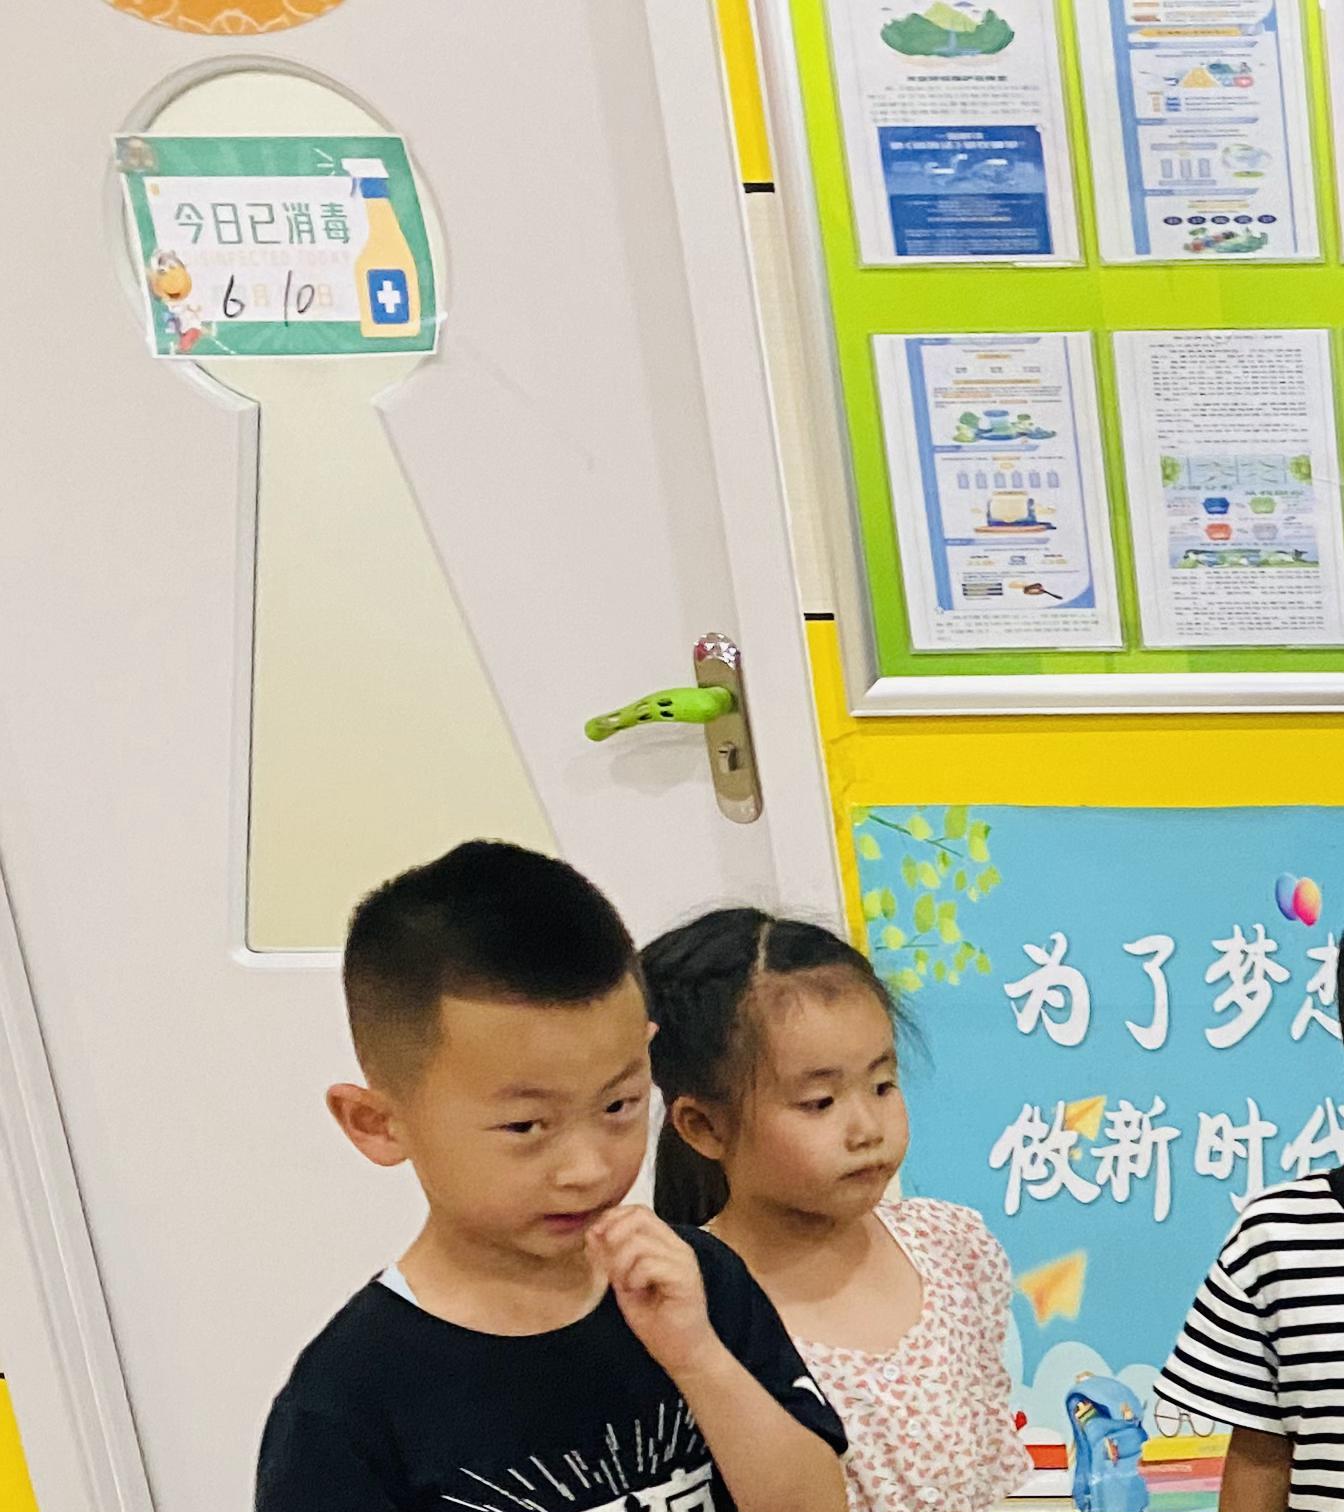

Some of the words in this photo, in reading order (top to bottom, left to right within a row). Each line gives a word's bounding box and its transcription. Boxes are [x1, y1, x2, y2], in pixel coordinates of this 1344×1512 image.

[175, 202, 350, 244] 今日已消毒
[223, 274, 245, 318] 6
